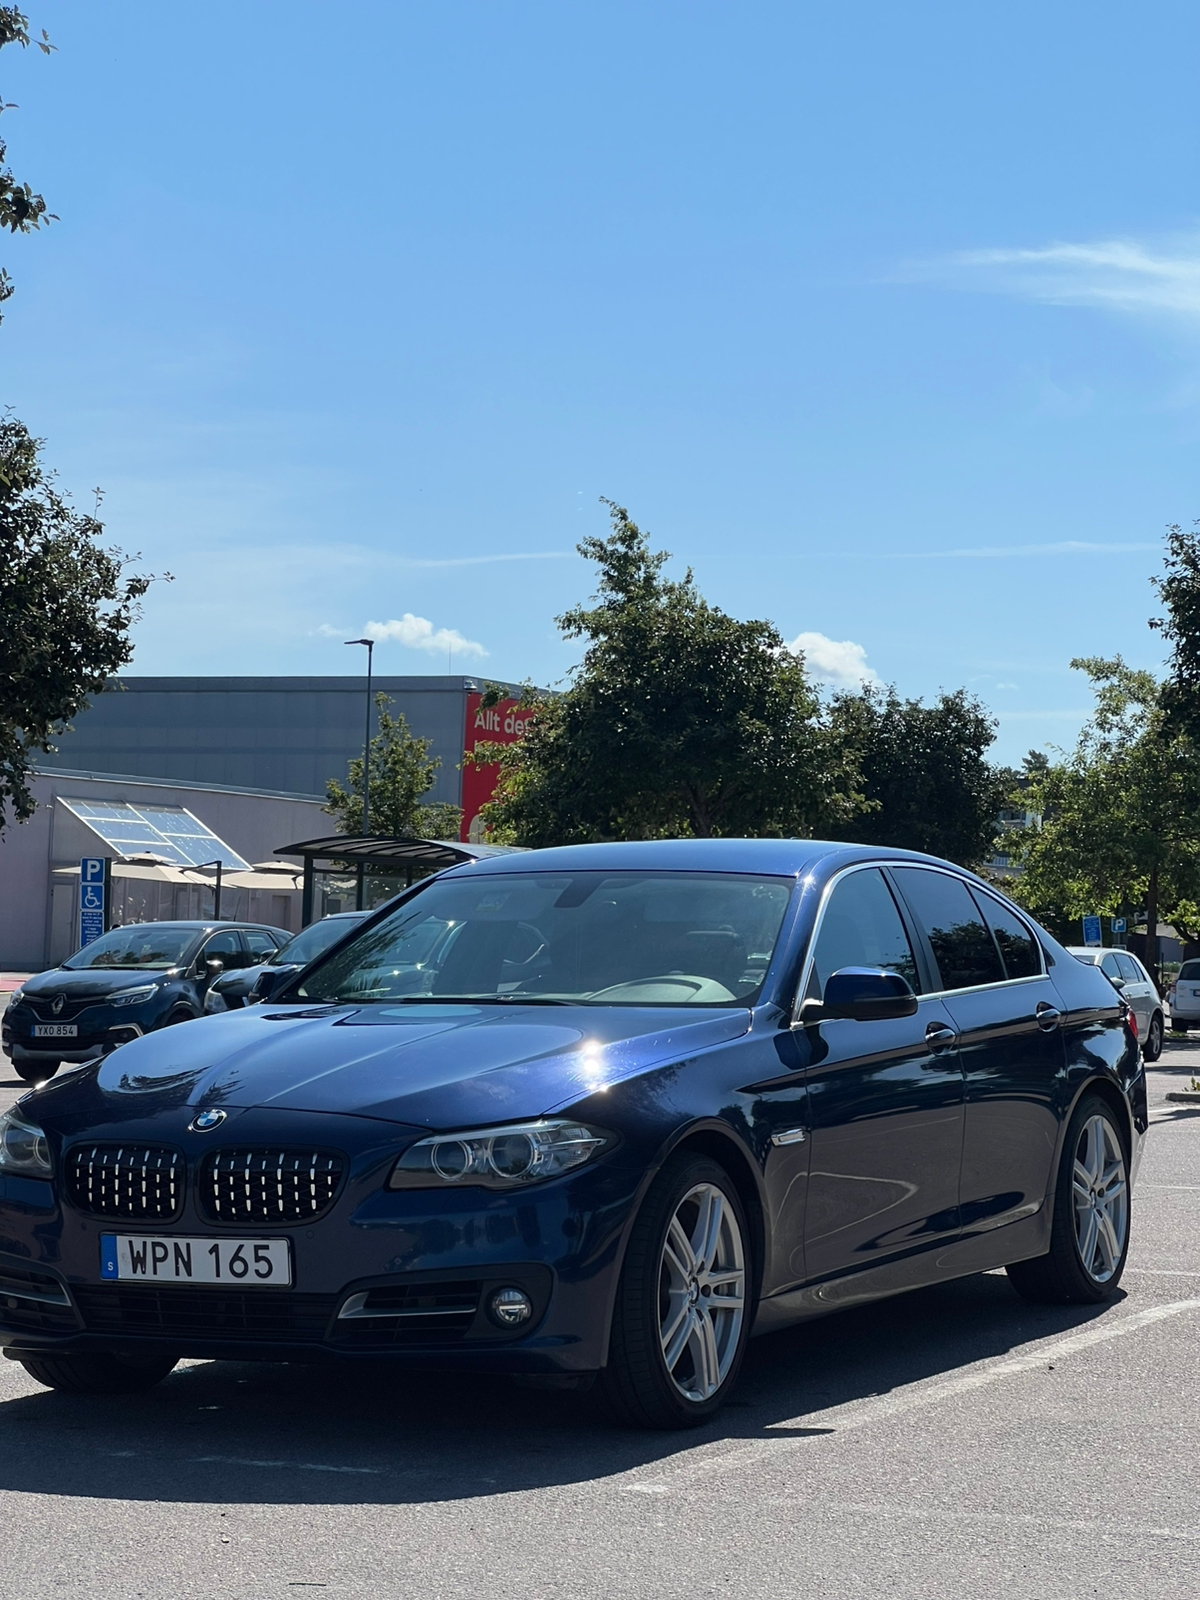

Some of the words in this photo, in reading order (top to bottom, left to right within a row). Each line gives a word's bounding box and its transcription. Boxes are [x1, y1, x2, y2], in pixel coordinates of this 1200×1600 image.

[474, 710, 500, 732] Allt
[86, 860, 101, 881] P
[1115, 919, 1124, 931] P
[56, 1026, 74, 1036] 854
[107, 1261, 114, 1271] S
[128, 1240, 193, 1277] WPN
[208, 1243, 273, 1279] 165
